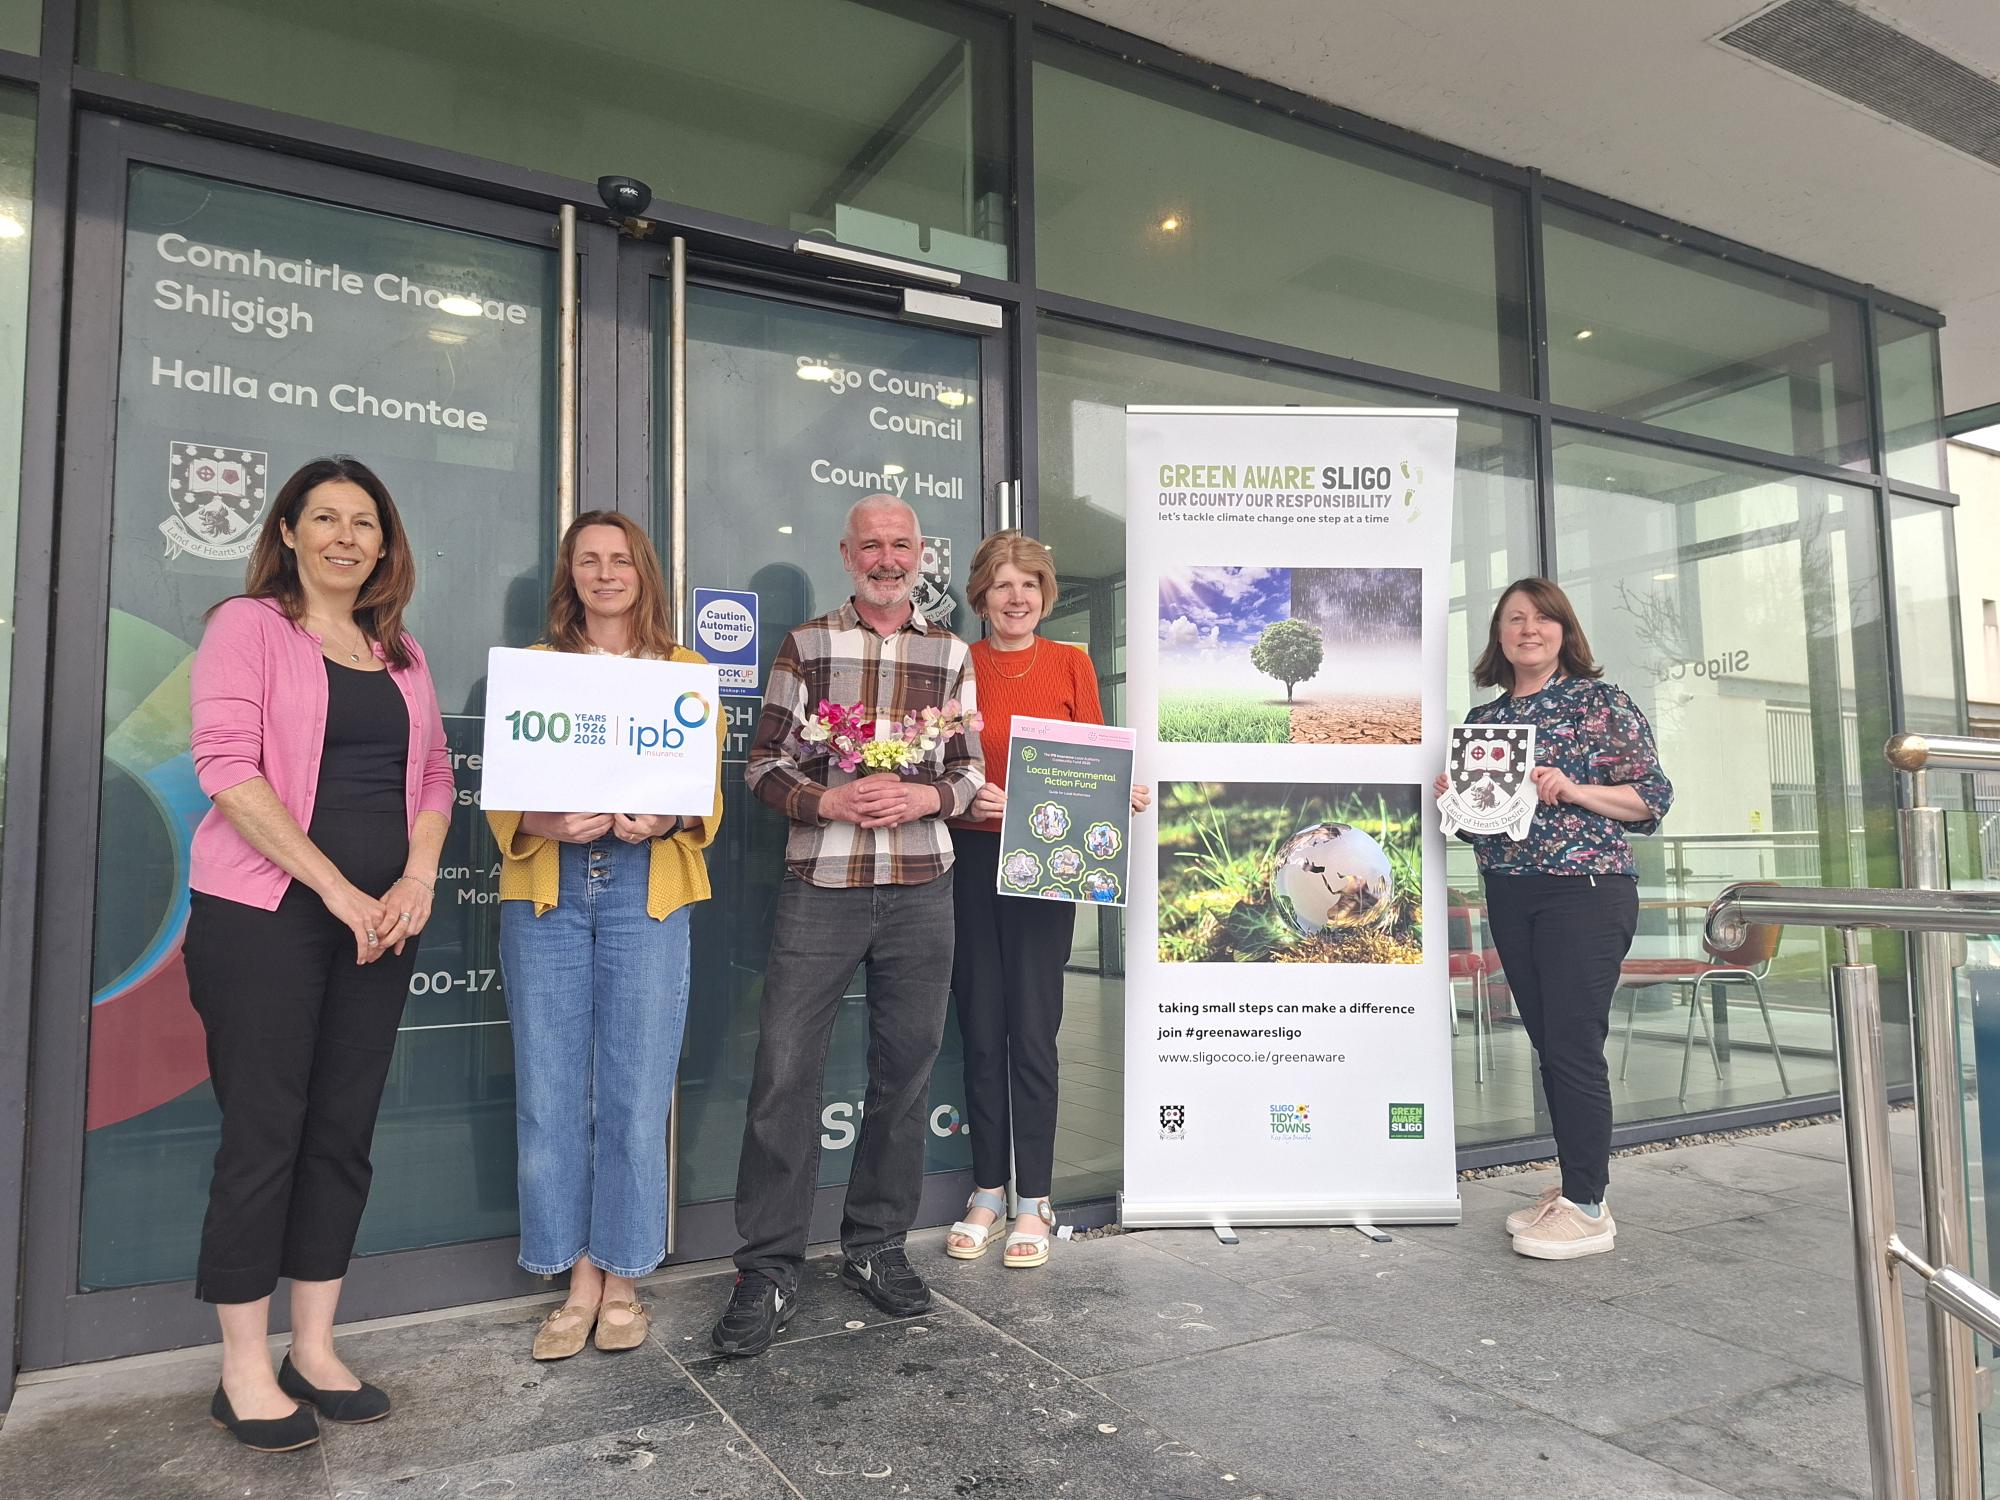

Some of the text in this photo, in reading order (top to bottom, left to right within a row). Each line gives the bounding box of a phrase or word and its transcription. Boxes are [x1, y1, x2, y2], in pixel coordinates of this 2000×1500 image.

[156, 232, 527, 325] Comhairle Choae
[153, 279, 313, 339] Shligigh
[151, 356, 487, 432] Halla an Chontae
[869, 406, 962, 441] Council
[810, 459, 963, 500] County Hall
[1159, 464, 1391, 490] GREEN AWARE SLIGO
[1159, 492, 1392, 508] OUR COUNTY OUR RESPONSIBILITY
[1158, 512, 1180, 521] let's
[1183, 512, 1214, 521] tackle
[1217, 513, 1255, 522] climate
[1257, 514, 1294, 524] change
[1318, 515, 1341, 525] step
[1343, 515, 1354, 523] at
[1365, 514, 1389, 523] time
[166, 526, 189, 547] Land
[191, 543, 202, 553] of
[706, 610, 746, 622] Caution
[700, 620, 753, 633] Automatic
[714, 632, 738, 642] Door
[575, 713, 607, 723] YEARS
[505, 710, 571, 743] 100
[575, 723, 606, 734] 1926
[574, 734, 606, 745] 2026
[629, 717, 685, 756] ipb
[722, 733, 749, 753] IT
[644, 749, 684, 758] insurance
[1026, 765, 1116, 782] Local Environmental
[1044, 777, 1097, 790] Action Fund
[1446, 804, 1462, 820] Land
[1463, 817, 1472, 825] of
[1501, 806, 1525, 824] Desire
[458, 888, 500, 904] Mon
[1158, 1002, 1415, 1016] taking small steps can make a difference
[1157, 1026, 1302, 1041] join #greenawaresligo
[1158, 1051, 1346, 1066] www.sligococo.ie/greenaware
[1269, 1104, 1295, 1112] SLIGO
[1391, 1107, 1422, 1116] GREEN
[1269, 1113, 1294, 1122] TIDY
[1391, 1115, 1422, 1123] AWARE
[1269, 1123, 1311, 1133] TOWNS
[1391, 1123, 1423, 1132] SLIGO
